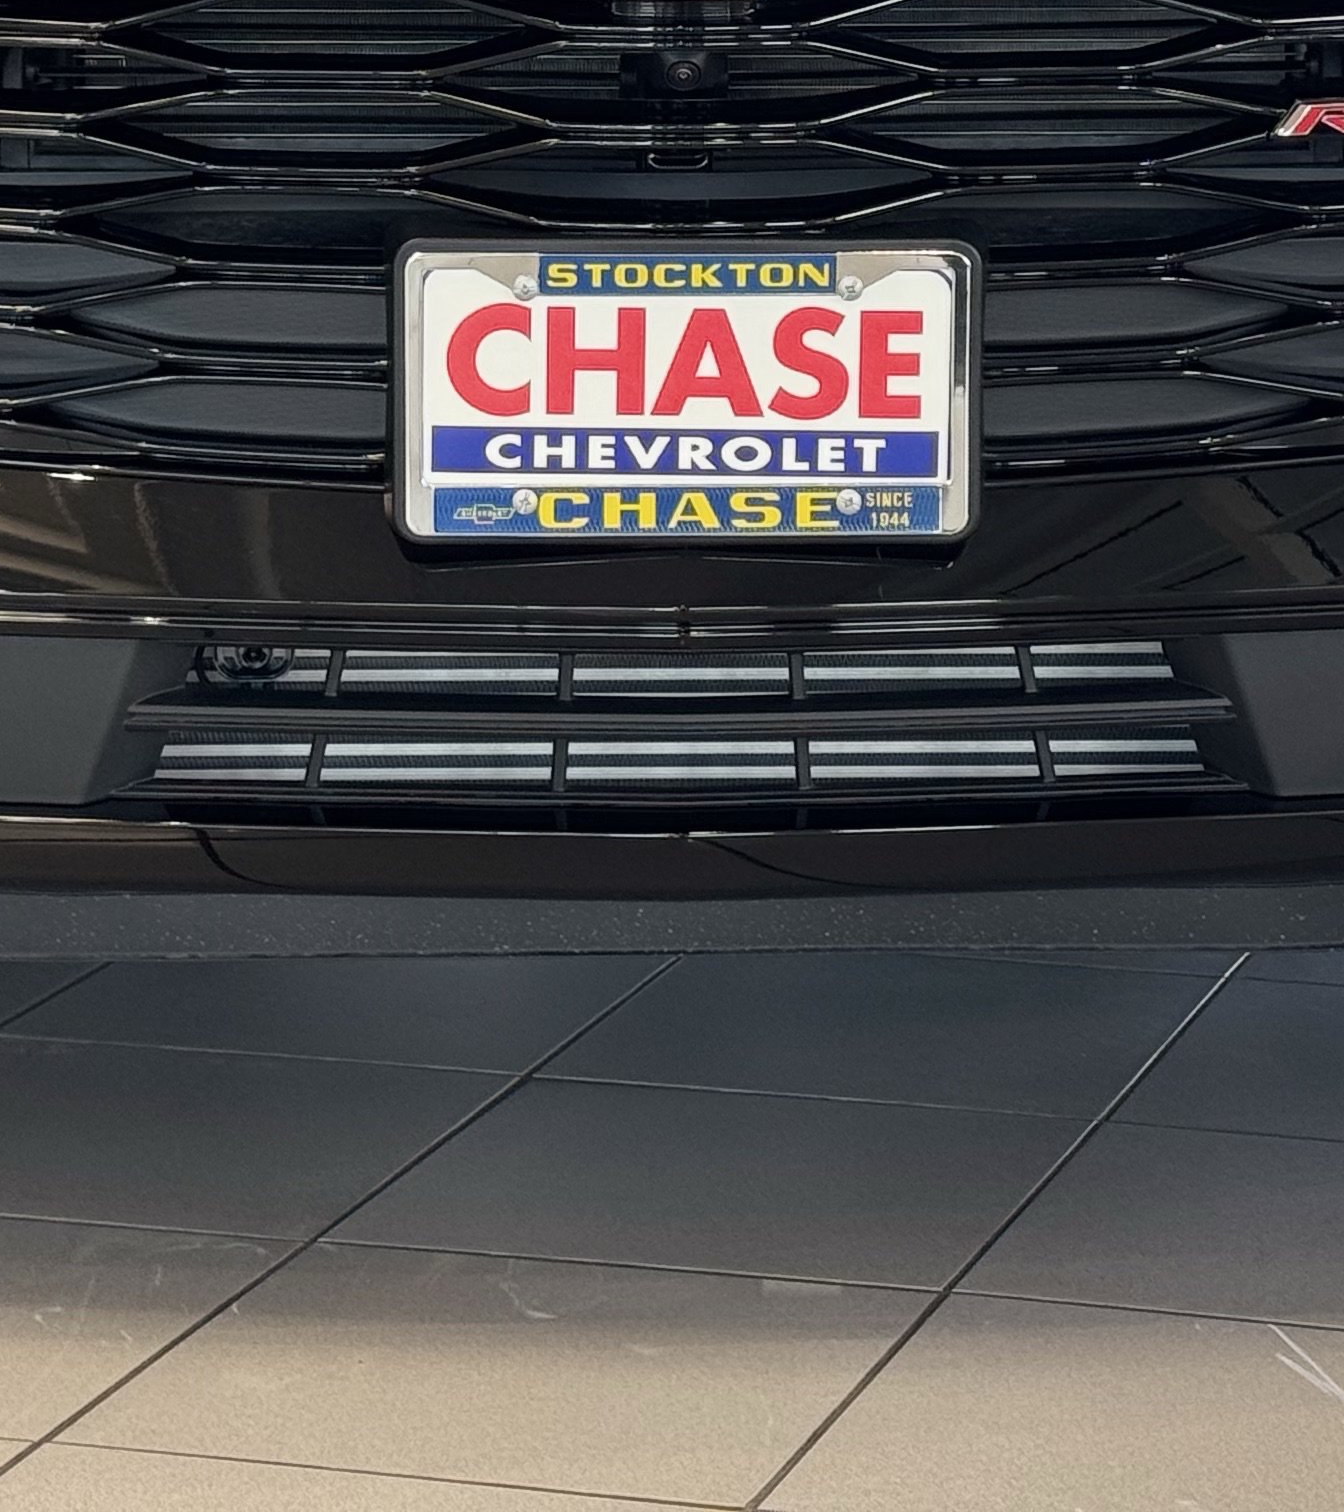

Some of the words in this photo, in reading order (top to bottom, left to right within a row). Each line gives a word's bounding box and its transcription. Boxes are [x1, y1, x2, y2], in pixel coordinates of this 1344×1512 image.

[546, 262, 831, 290] STOCKTON
[446, 302, 924, 420] CHASE
[484, 433, 888, 473] CHEVROLET
[538, 489, 841, 530] CHASE
[865, 491, 914, 509] SINCE
